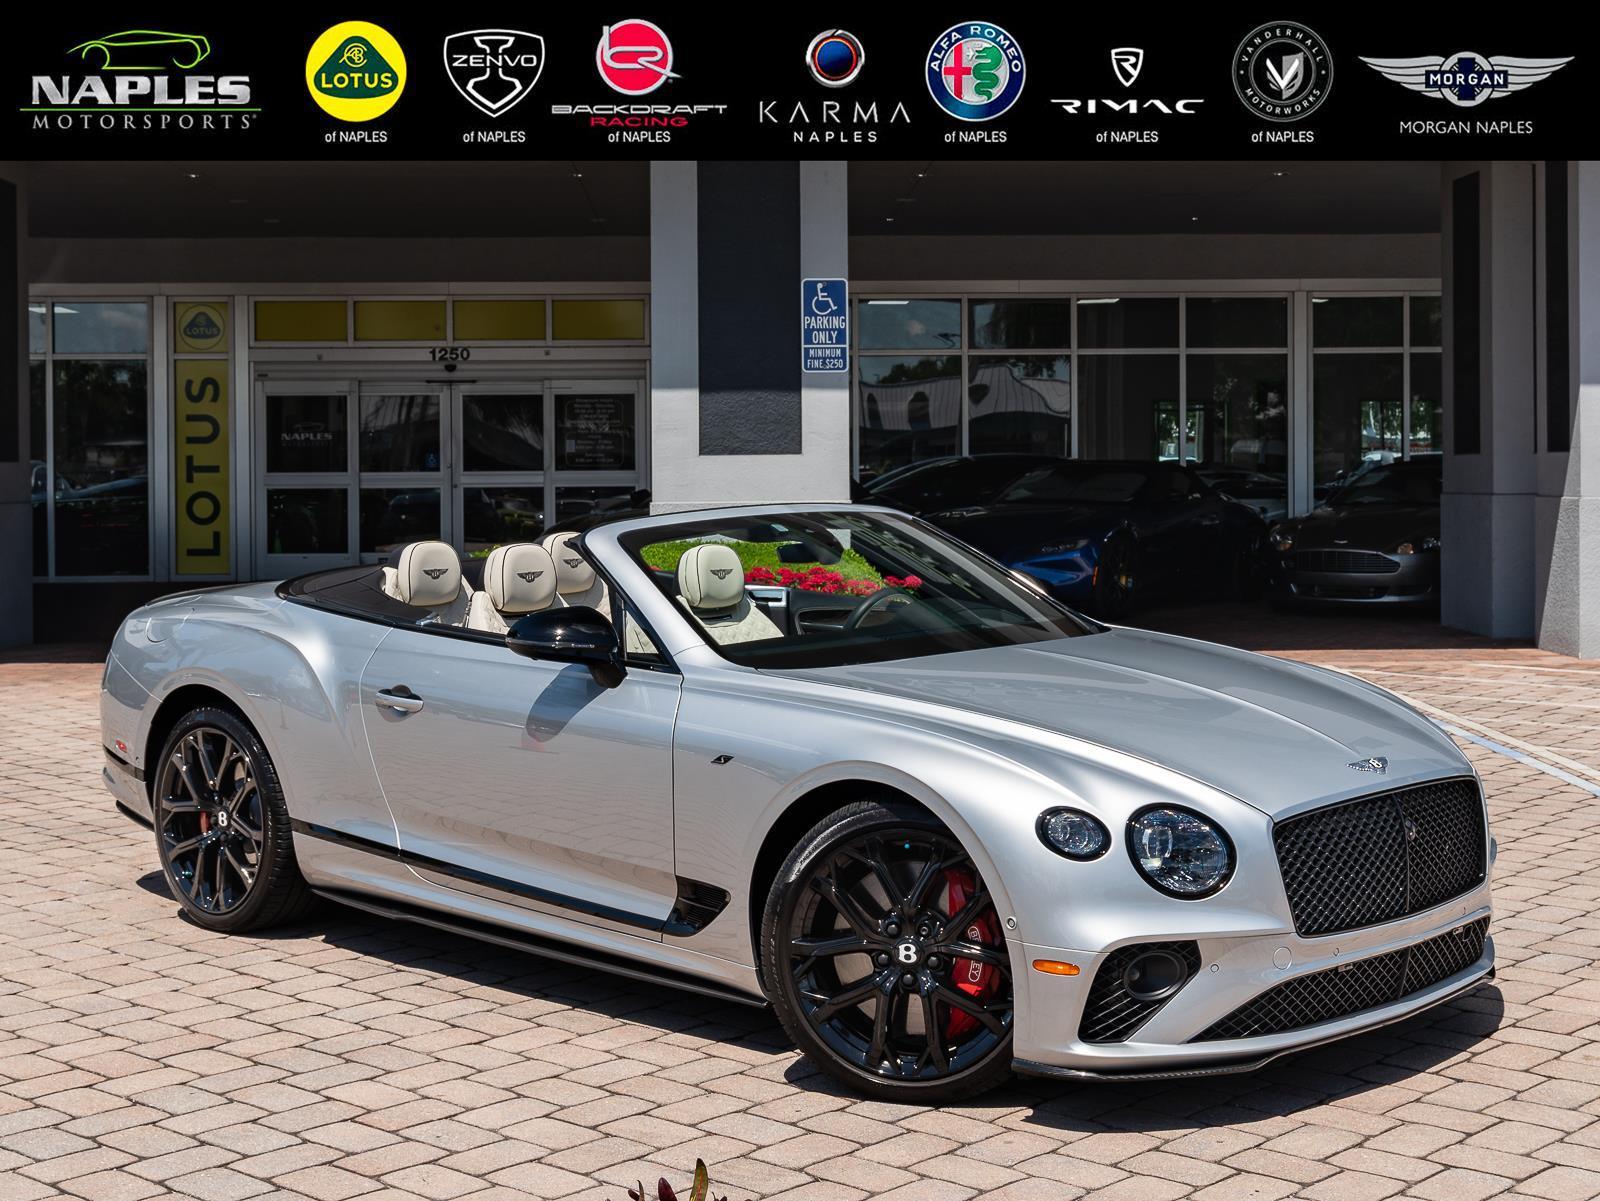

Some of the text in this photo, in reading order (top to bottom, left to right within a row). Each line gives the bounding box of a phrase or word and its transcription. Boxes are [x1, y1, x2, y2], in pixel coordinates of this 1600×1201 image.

[804, 316, 846, 329] PARKING
[186, 327, 219, 336] LOTUS
[812, 330, 838, 344] ONLY
[429, 347, 471, 362] 1250
[809, 348, 841, 358] MINIMUM
[807, 359, 844, 369] FINE $250
[281, 432, 333, 441] NAPLES
[185, 376, 221, 557] LOTUS
